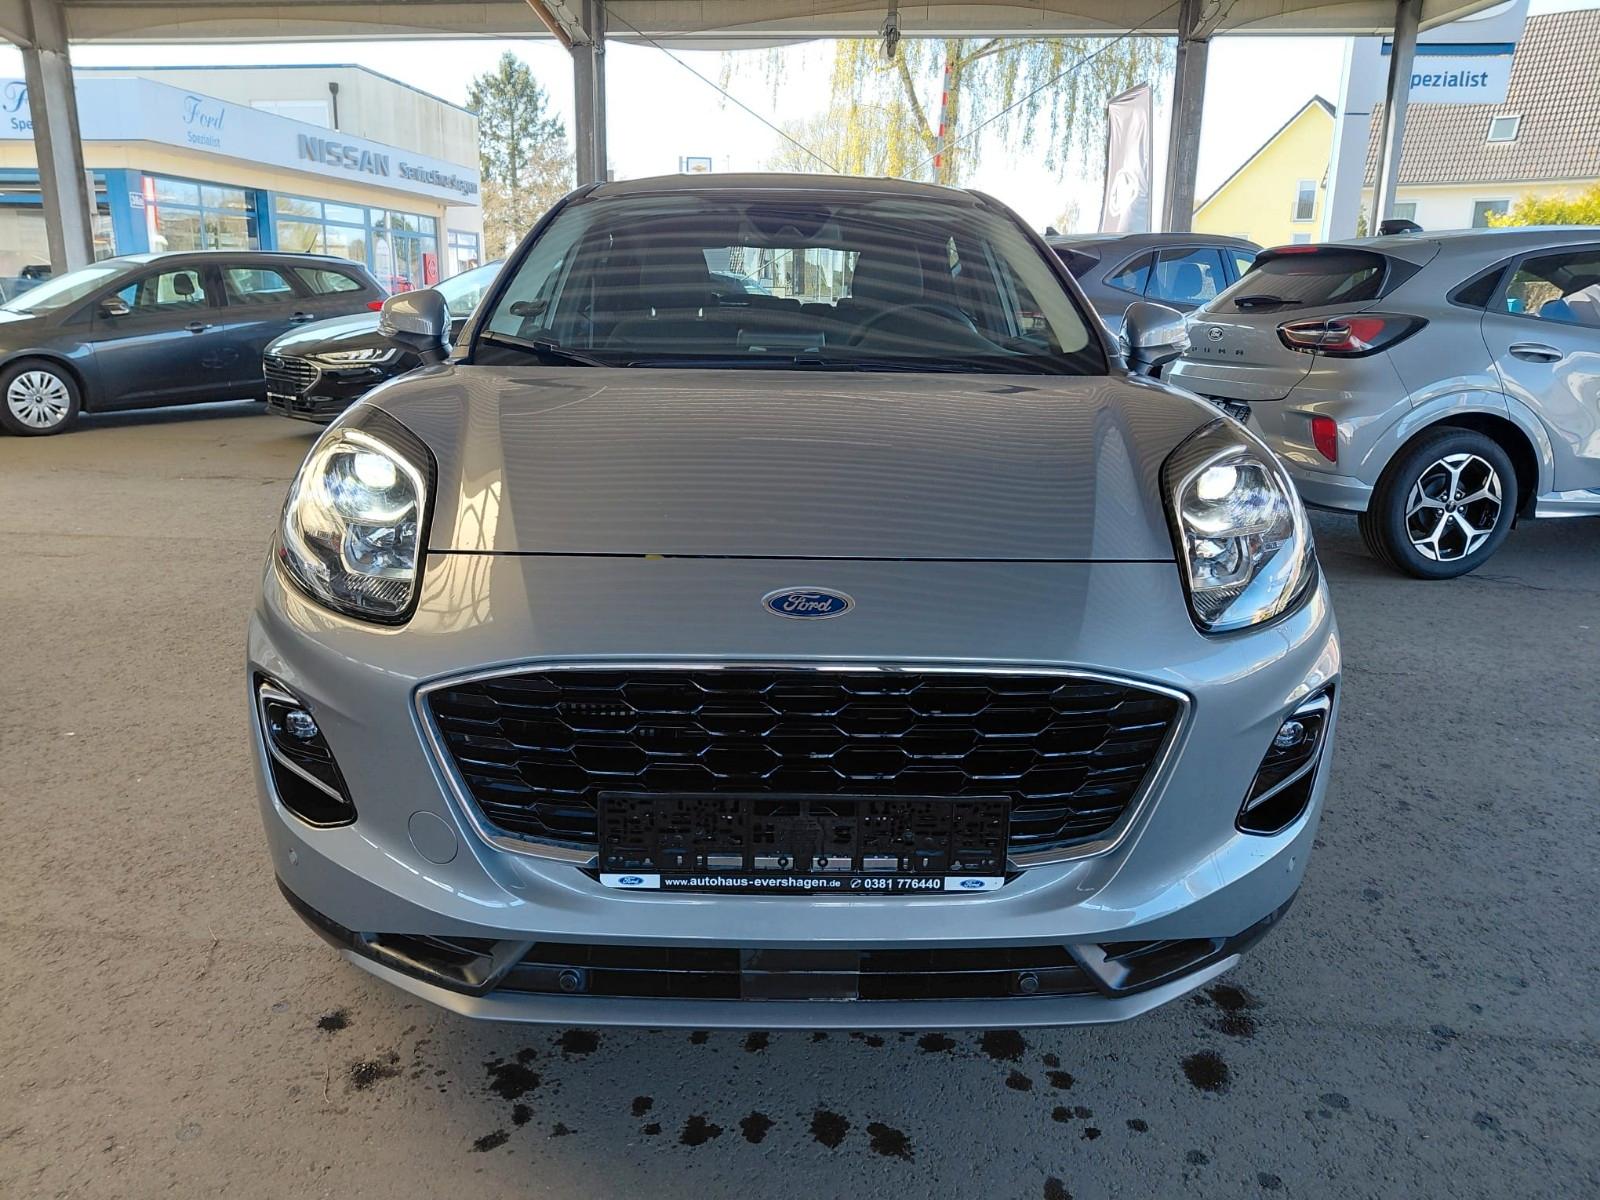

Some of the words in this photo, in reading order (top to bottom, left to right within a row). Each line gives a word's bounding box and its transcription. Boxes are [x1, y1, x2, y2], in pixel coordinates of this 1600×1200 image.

[1410, 71, 1488, 89] pezialist
[182, 95, 225, 129] Ford
[297, 134, 390, 177] NISSAN
[783, 594, 833, 612] Ford
[665, 876, 841, 889] www.autohaus-evershagen.de
[864, 878, 893, 889] 0381
[897, 879, 941, 889] 776440
